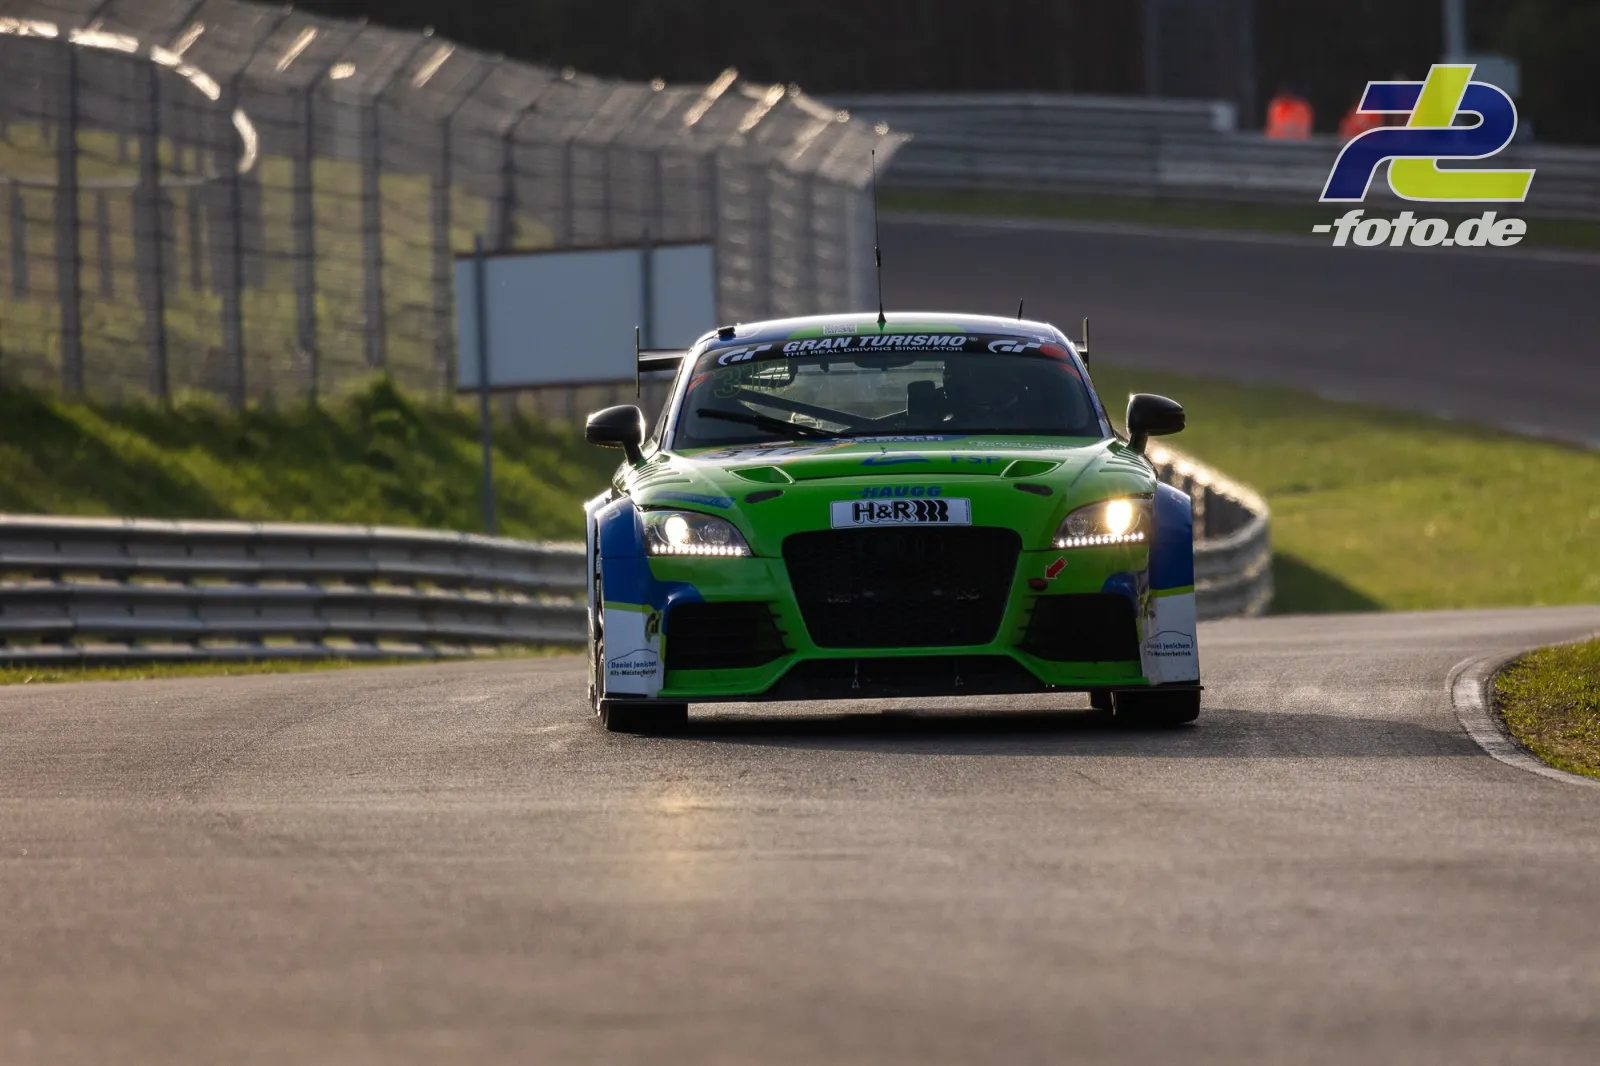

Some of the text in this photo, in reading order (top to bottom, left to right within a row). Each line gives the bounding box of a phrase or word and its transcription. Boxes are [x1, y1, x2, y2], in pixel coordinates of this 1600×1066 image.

[782, 336, 852, 353] GRAN
[861, 485, 943, 498] HAUGG
[852, 500, 918, 524] H&R
[1147, 642, 1163, 650] niel
[611, 661, 632, 669] Daniel
